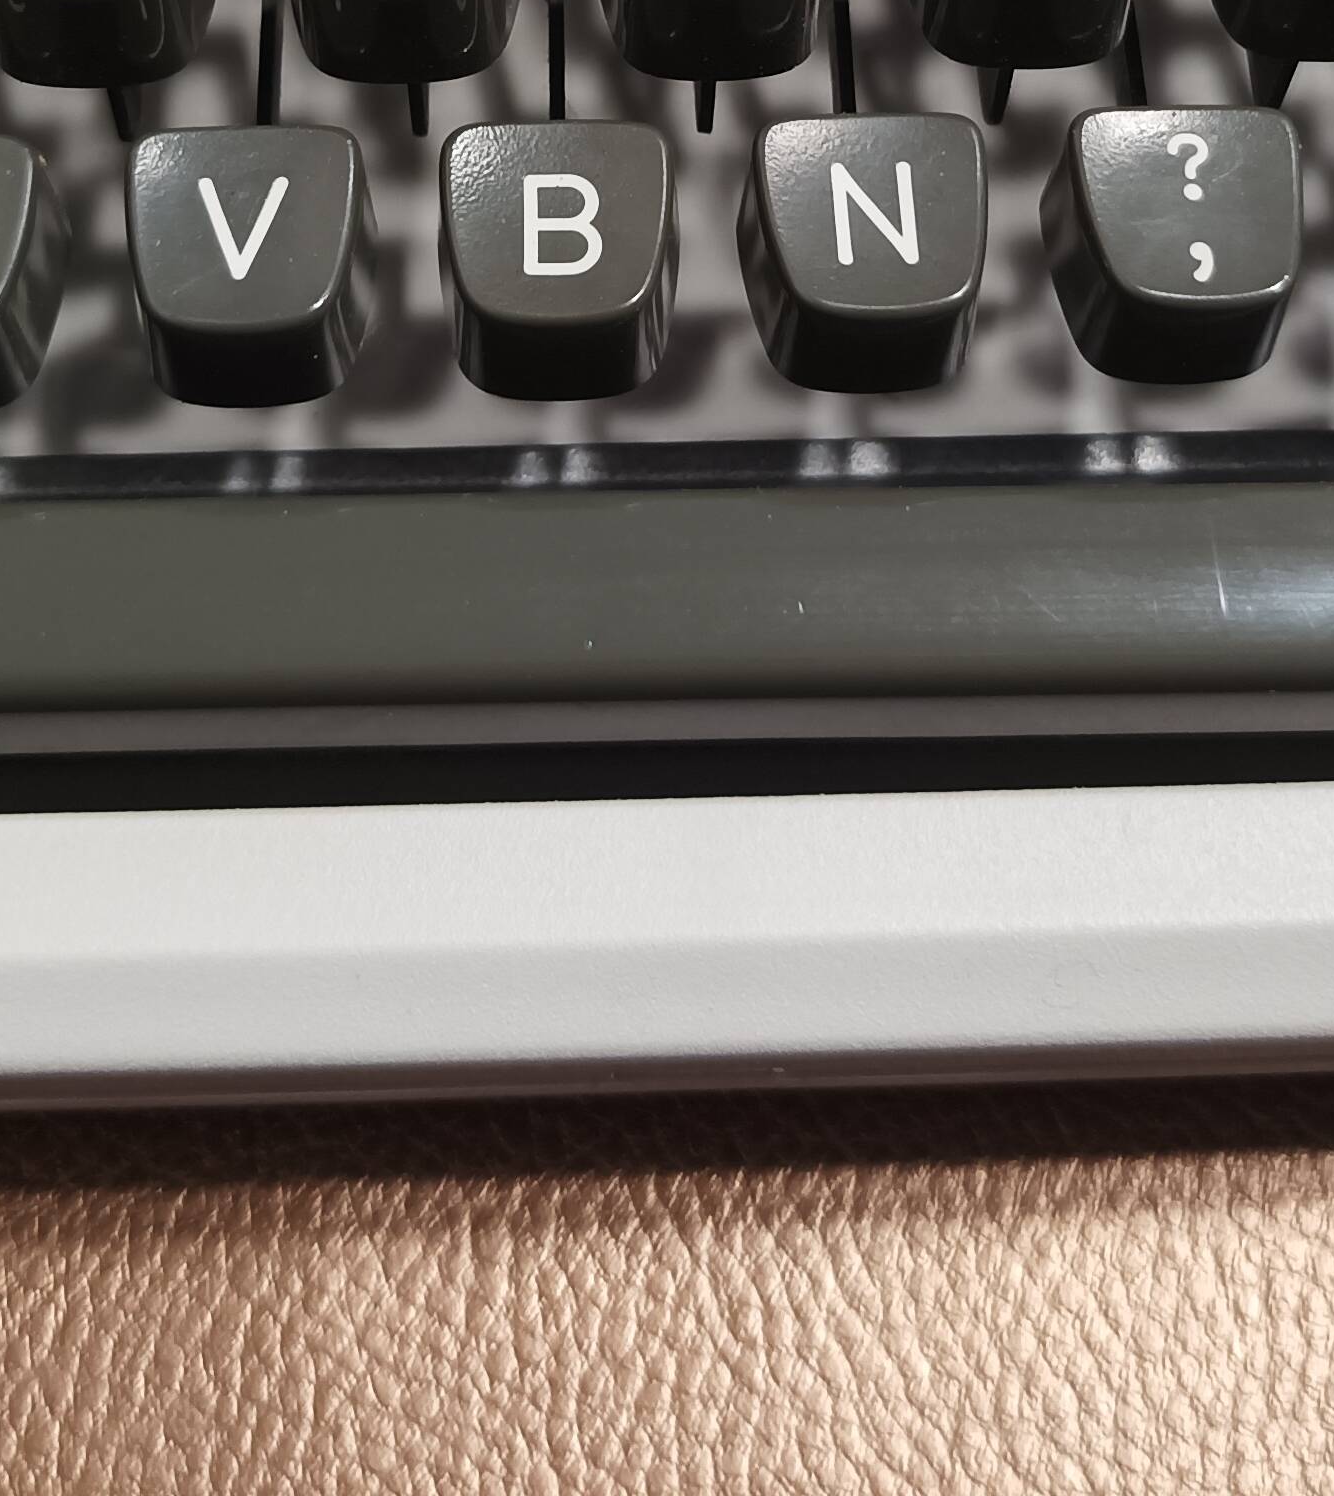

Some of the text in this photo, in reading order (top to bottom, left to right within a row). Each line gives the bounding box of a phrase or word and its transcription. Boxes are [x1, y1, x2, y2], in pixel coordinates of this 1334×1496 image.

[830, 161, 920, 266] N
[1167, 133, 1210, 201] ?
[197, 176, 289, 281] V
[521, 173, 603, 276] B
